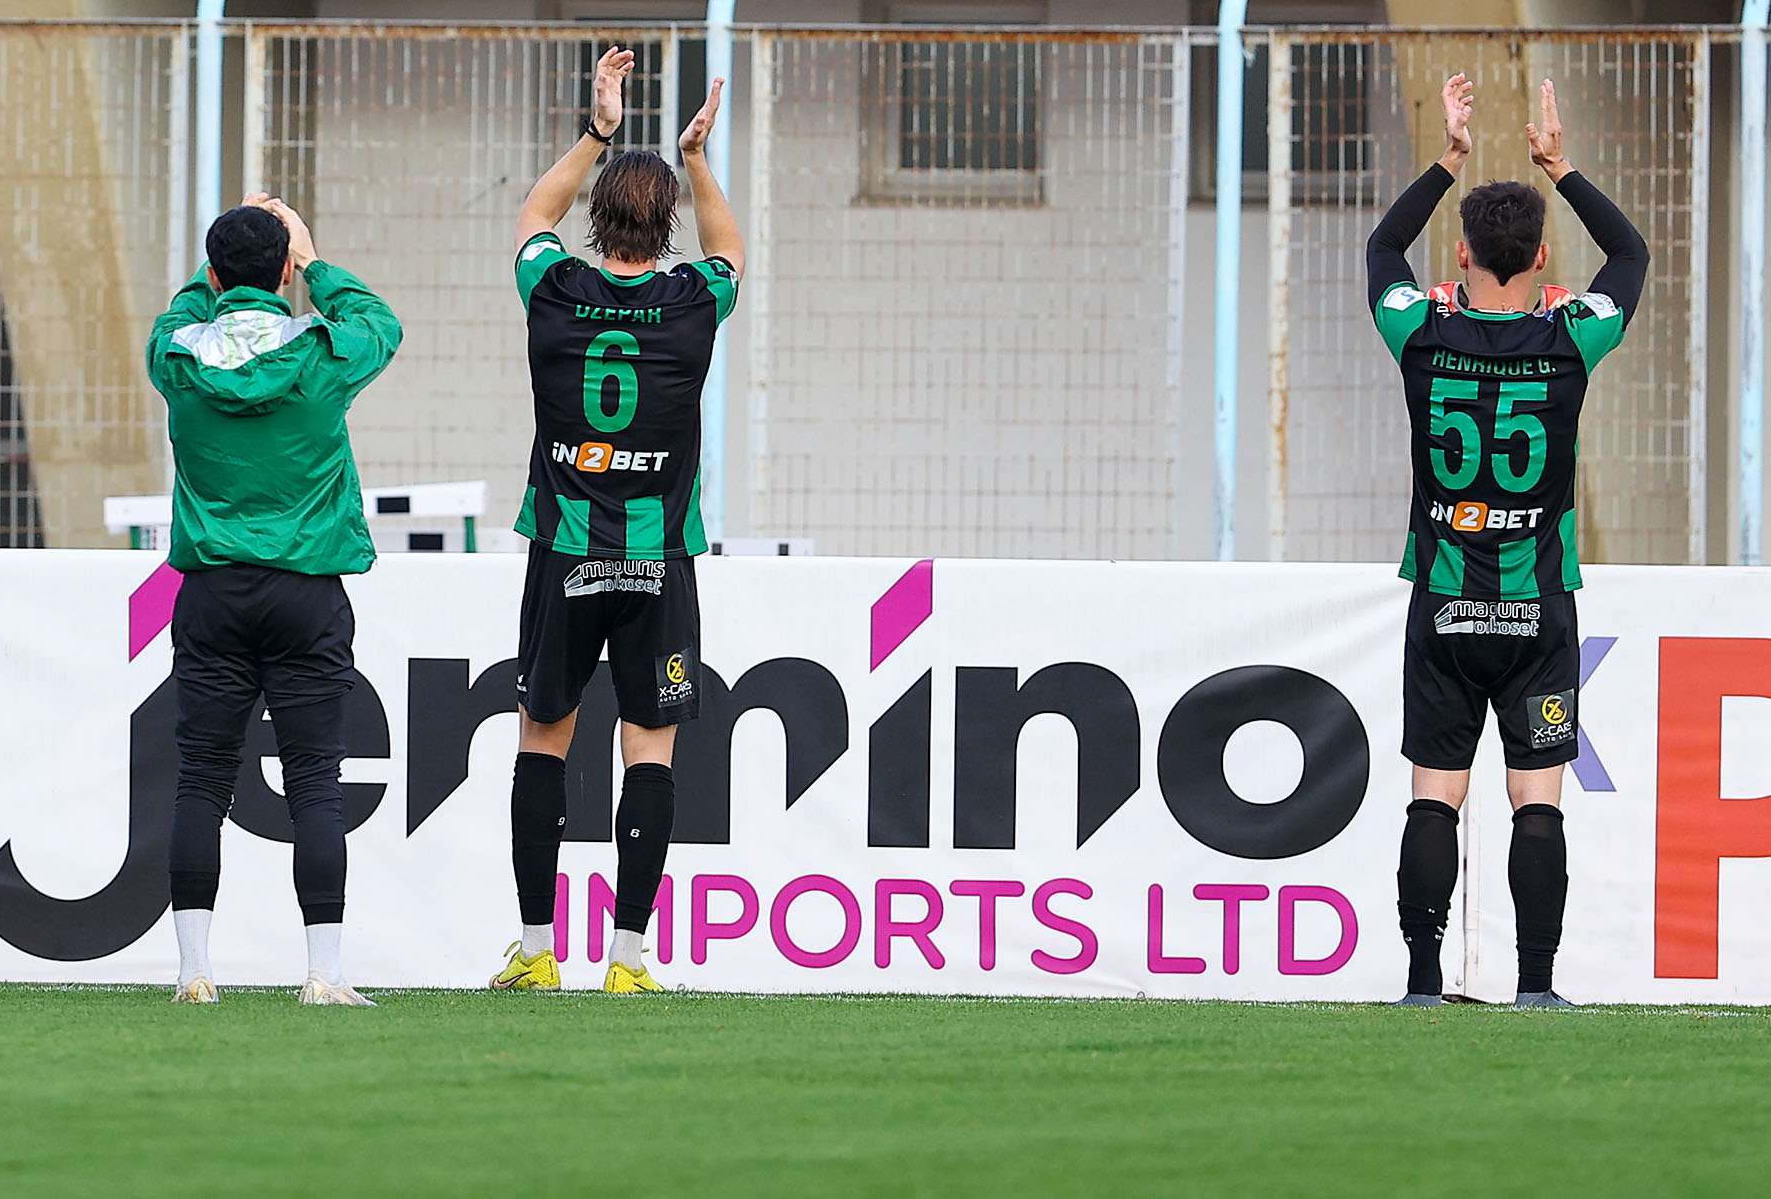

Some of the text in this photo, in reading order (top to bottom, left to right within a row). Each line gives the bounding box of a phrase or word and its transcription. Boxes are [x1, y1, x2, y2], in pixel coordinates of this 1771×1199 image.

[583, 330, 641, 433] 6
[1432, 350, 1533, 375] HENRIQUE
[1430, 377, 1548, 493] 55
[553, 872, 1359, 976] IMPORTS LTD
